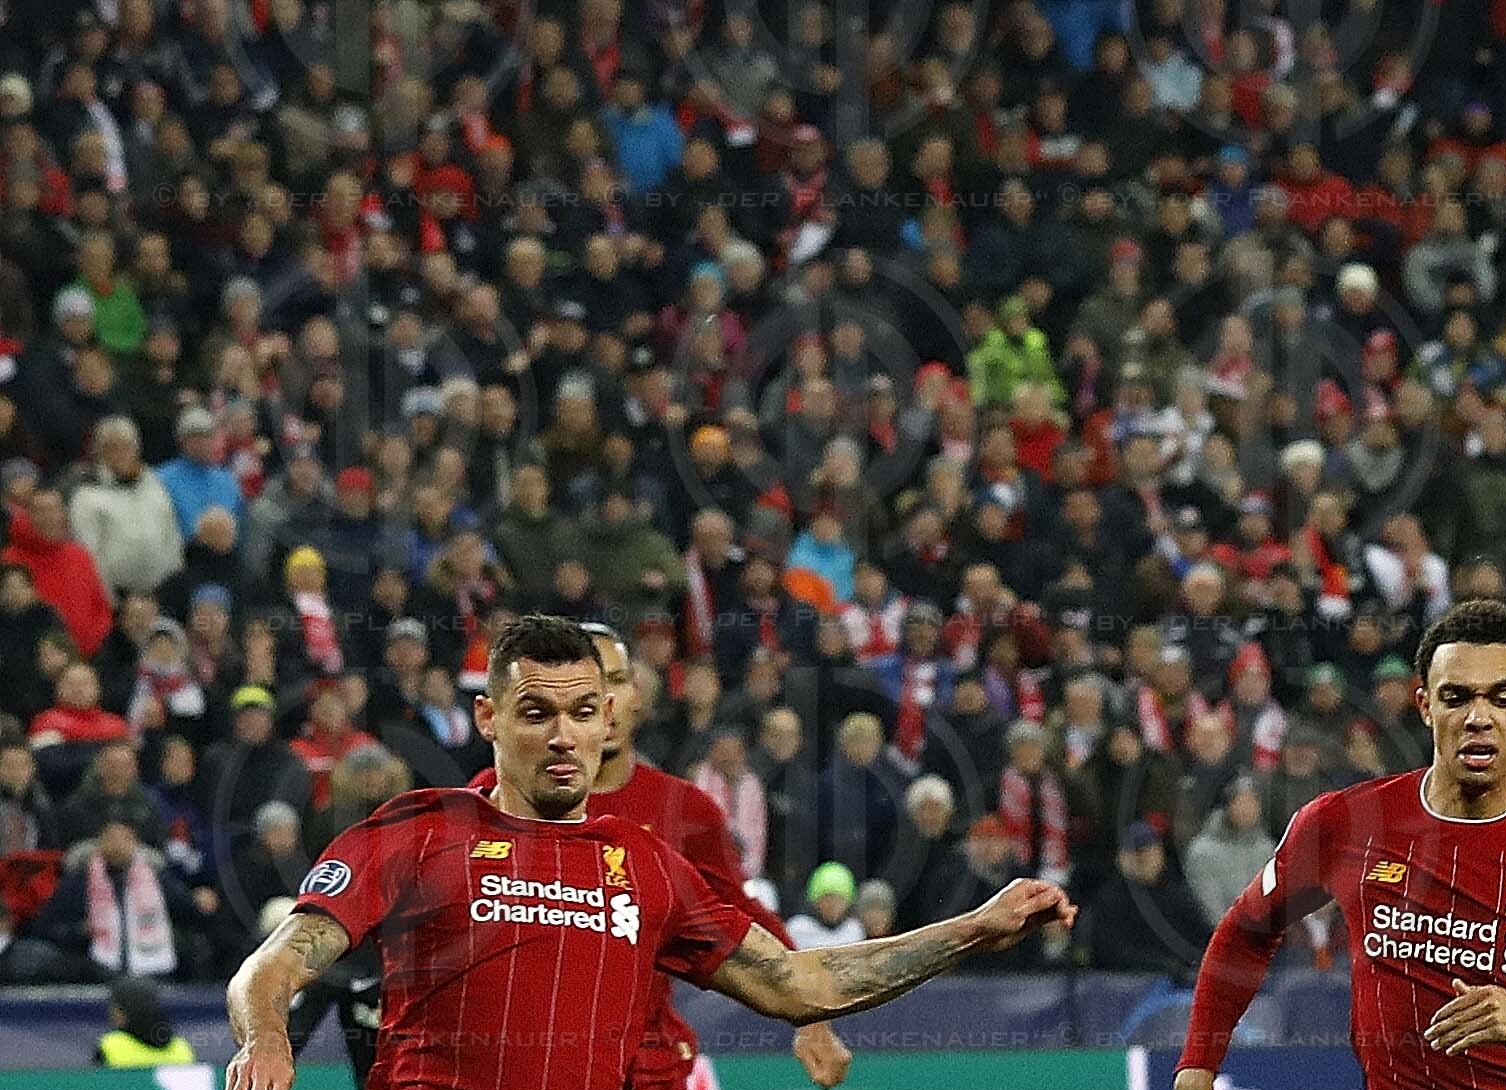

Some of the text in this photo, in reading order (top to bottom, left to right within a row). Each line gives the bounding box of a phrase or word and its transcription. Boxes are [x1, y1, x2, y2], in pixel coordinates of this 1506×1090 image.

[481, 875, 605, 907] Standard
[470, 899, 606, 932] Chartered
[1373, 905, 1498, 943] Standard
[1364, 933, 1495, 971] Chartered
